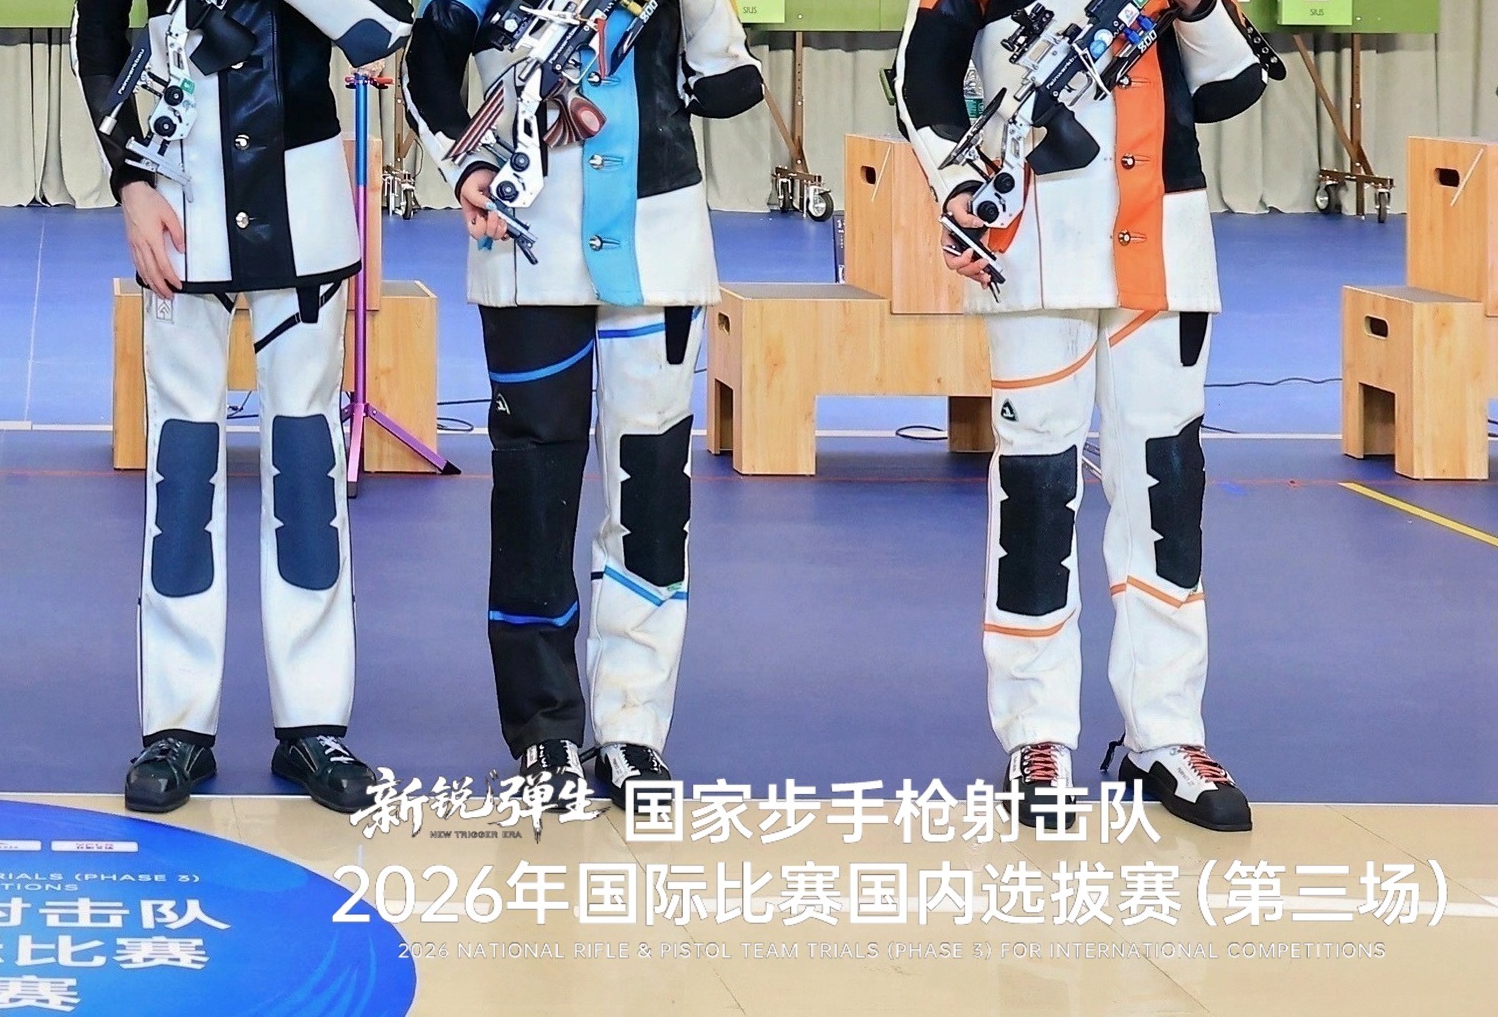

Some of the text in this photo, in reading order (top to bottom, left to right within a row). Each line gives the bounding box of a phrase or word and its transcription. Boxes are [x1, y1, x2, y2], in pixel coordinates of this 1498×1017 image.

[743, 6, 757, 14] SIUS
[1137, 30, 1158, 54] 800
[74, 872, 167, 883] (PHASE
